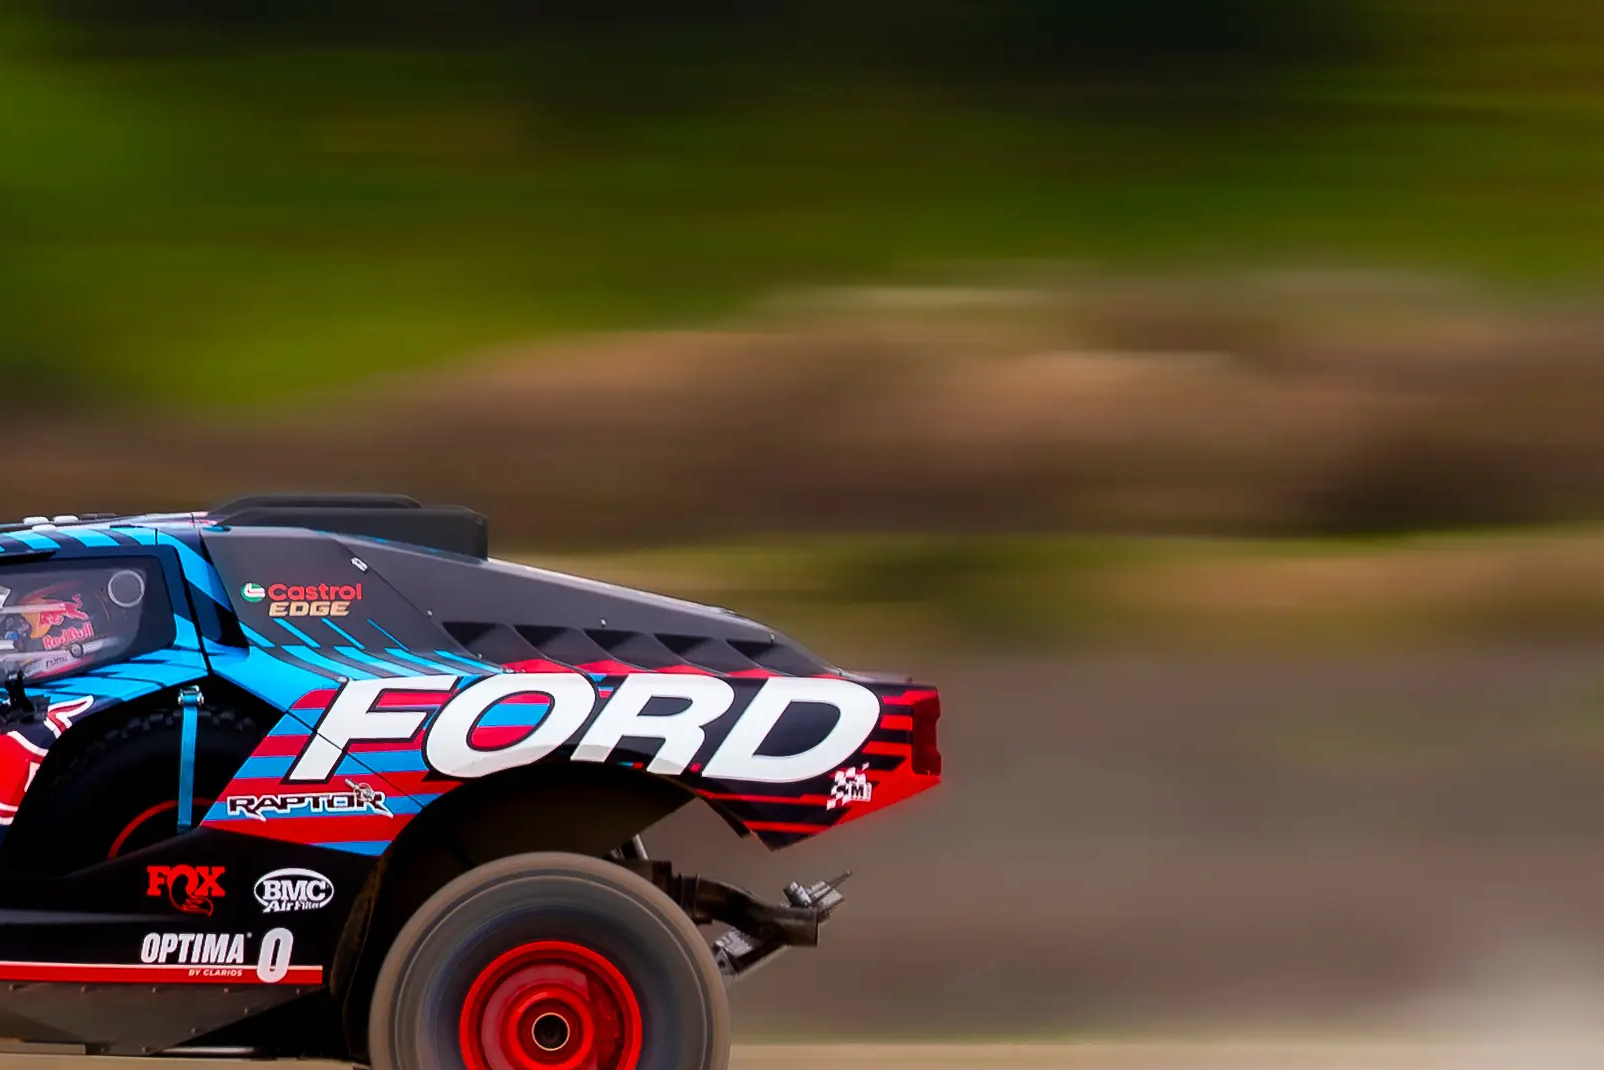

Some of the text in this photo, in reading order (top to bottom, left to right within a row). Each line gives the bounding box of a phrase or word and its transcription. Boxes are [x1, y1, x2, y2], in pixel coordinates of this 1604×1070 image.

[267, 583, 362, 600] Castrol
[268, 601, 351, 617] EDGE
[288, 672, 880, 783] FORD
[227, 790, 394, 822] RAPTOR
[147, 864, 225, 897] FOX
[262, 879, 326, 901] BMC
[262, 899, 294, 914] Air
[140, 932, 245, 964] OPTIMA
[188, 969, 243, 977] BY CLARIOS
